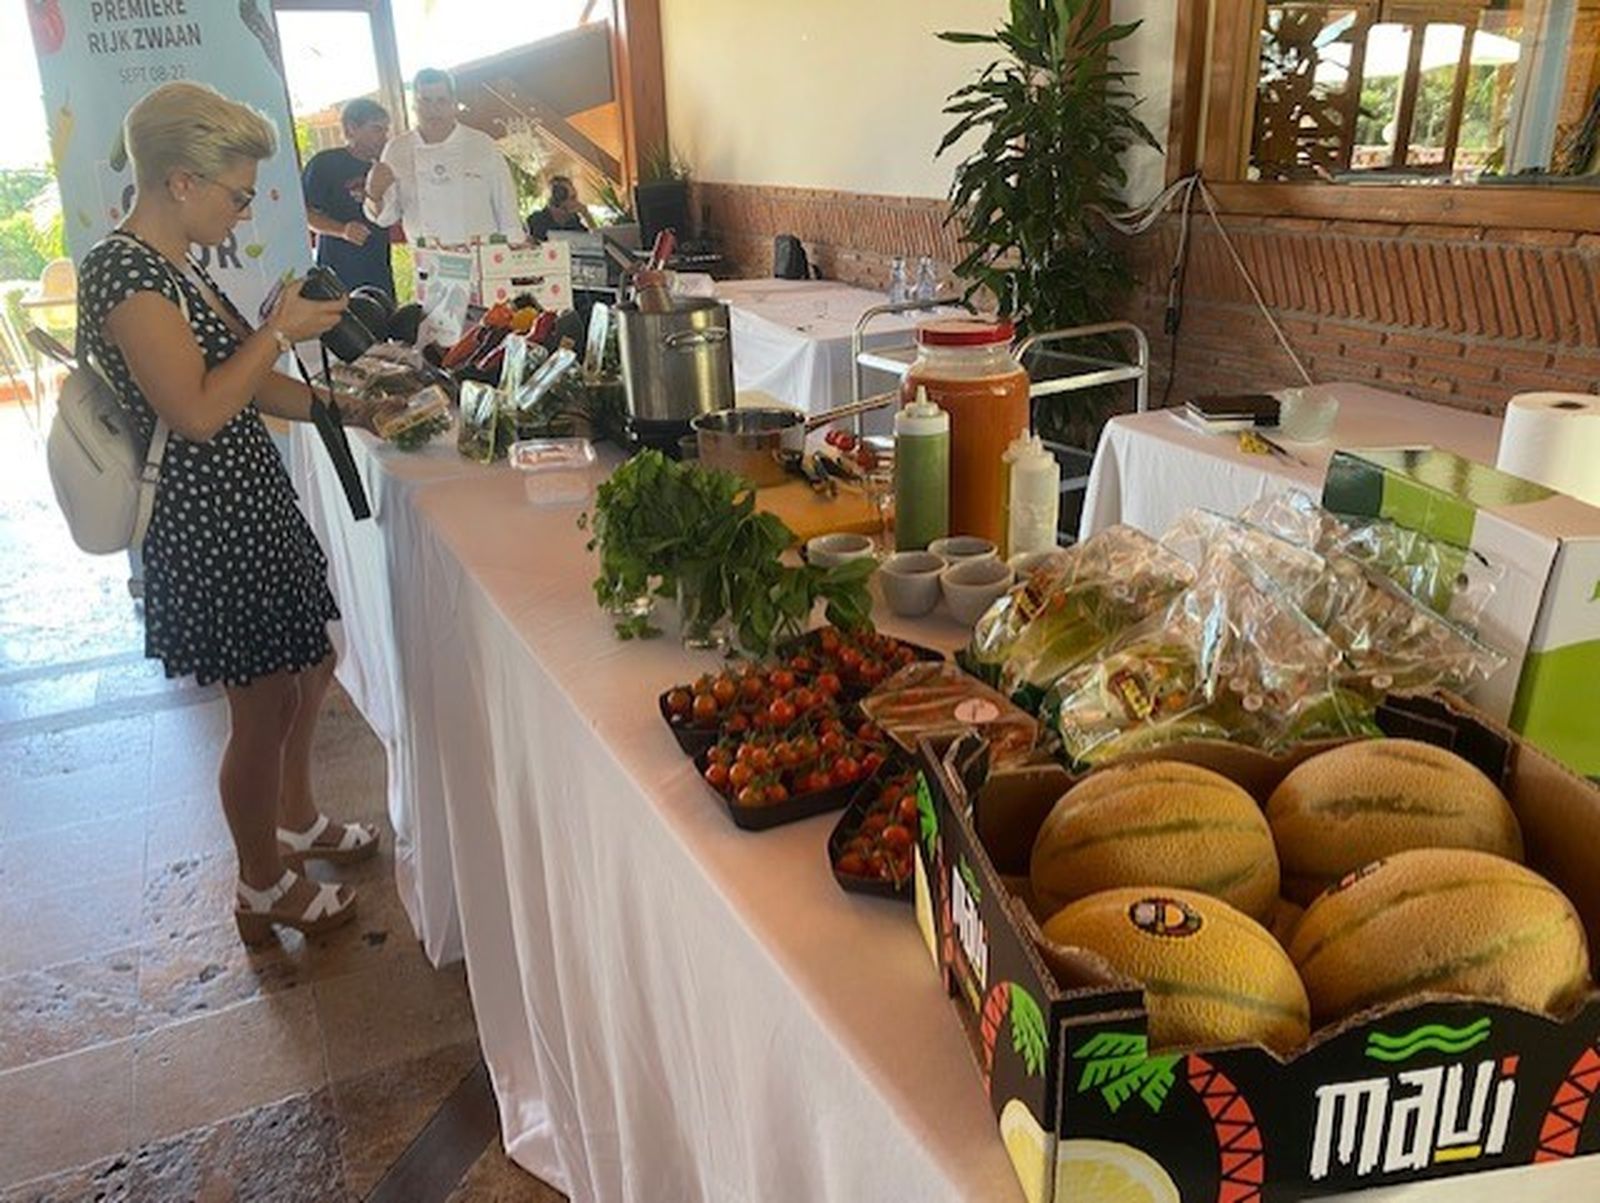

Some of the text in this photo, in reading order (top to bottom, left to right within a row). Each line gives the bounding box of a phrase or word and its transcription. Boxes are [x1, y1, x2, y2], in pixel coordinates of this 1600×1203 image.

[91, 0, 187, 23] PREMIERE
[87, 22, 202, 54] RIJK ZWAAN
